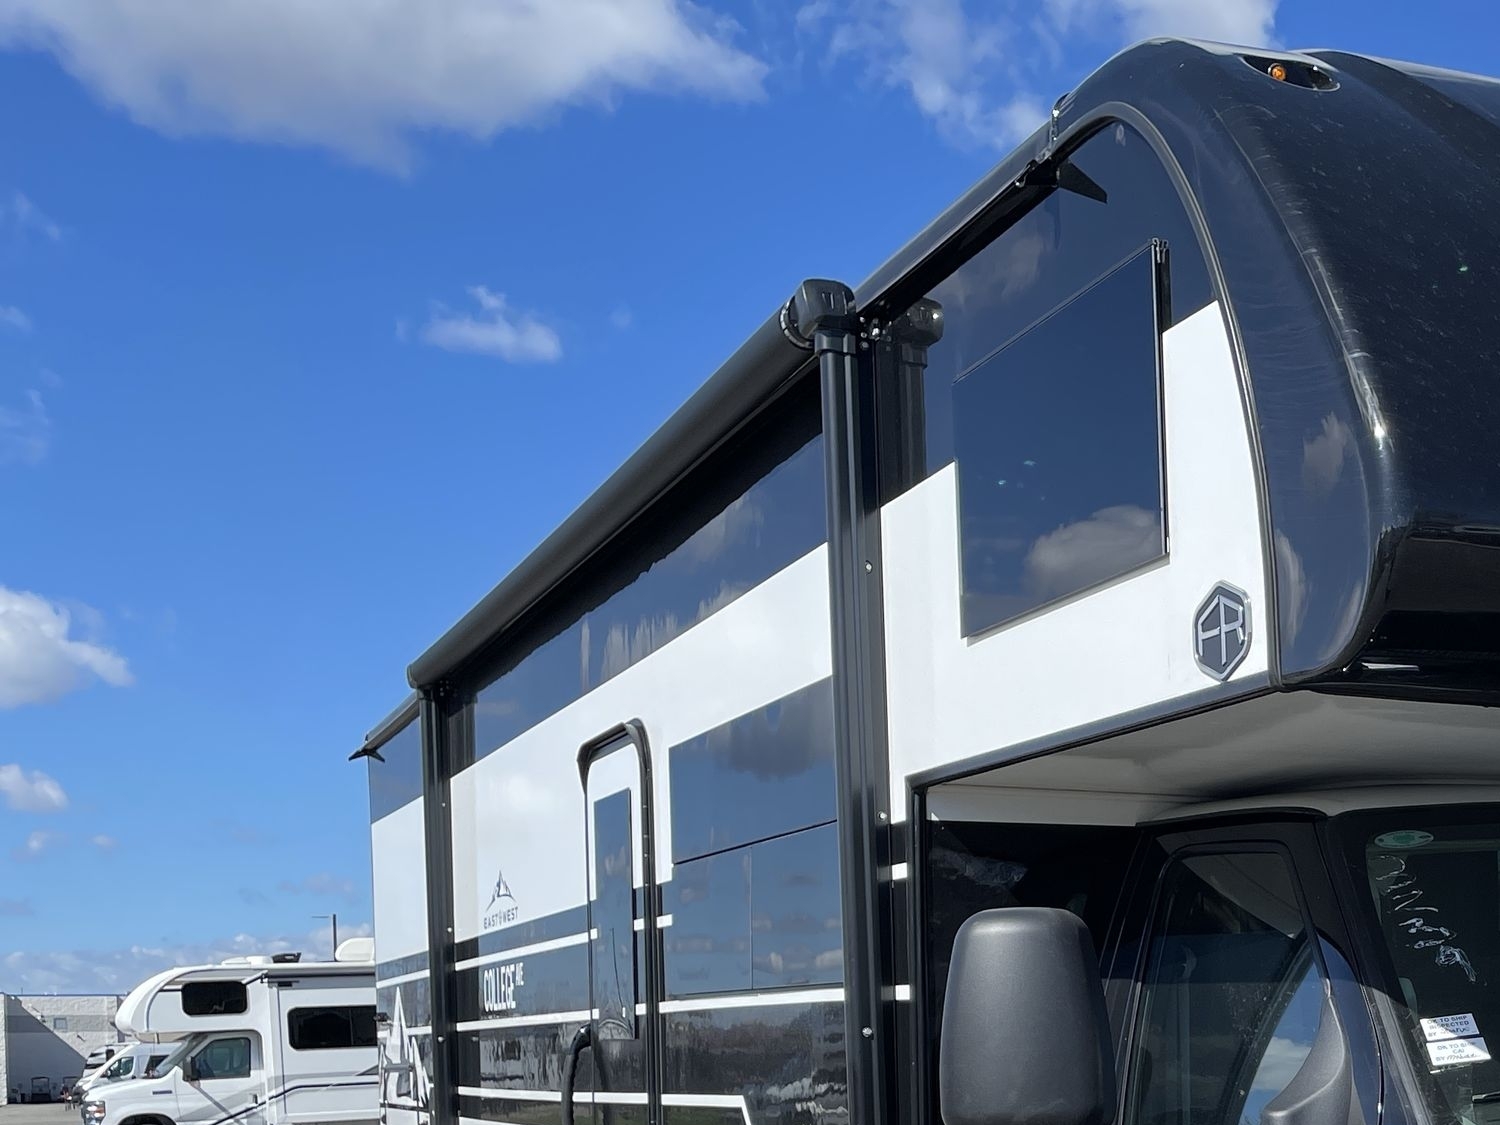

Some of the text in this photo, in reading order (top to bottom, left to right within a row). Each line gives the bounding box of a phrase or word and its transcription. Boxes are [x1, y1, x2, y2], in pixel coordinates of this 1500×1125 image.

[484, 906, 519, 930] EAST WEST
[483, 963, 516, 1012] COLLEGE
